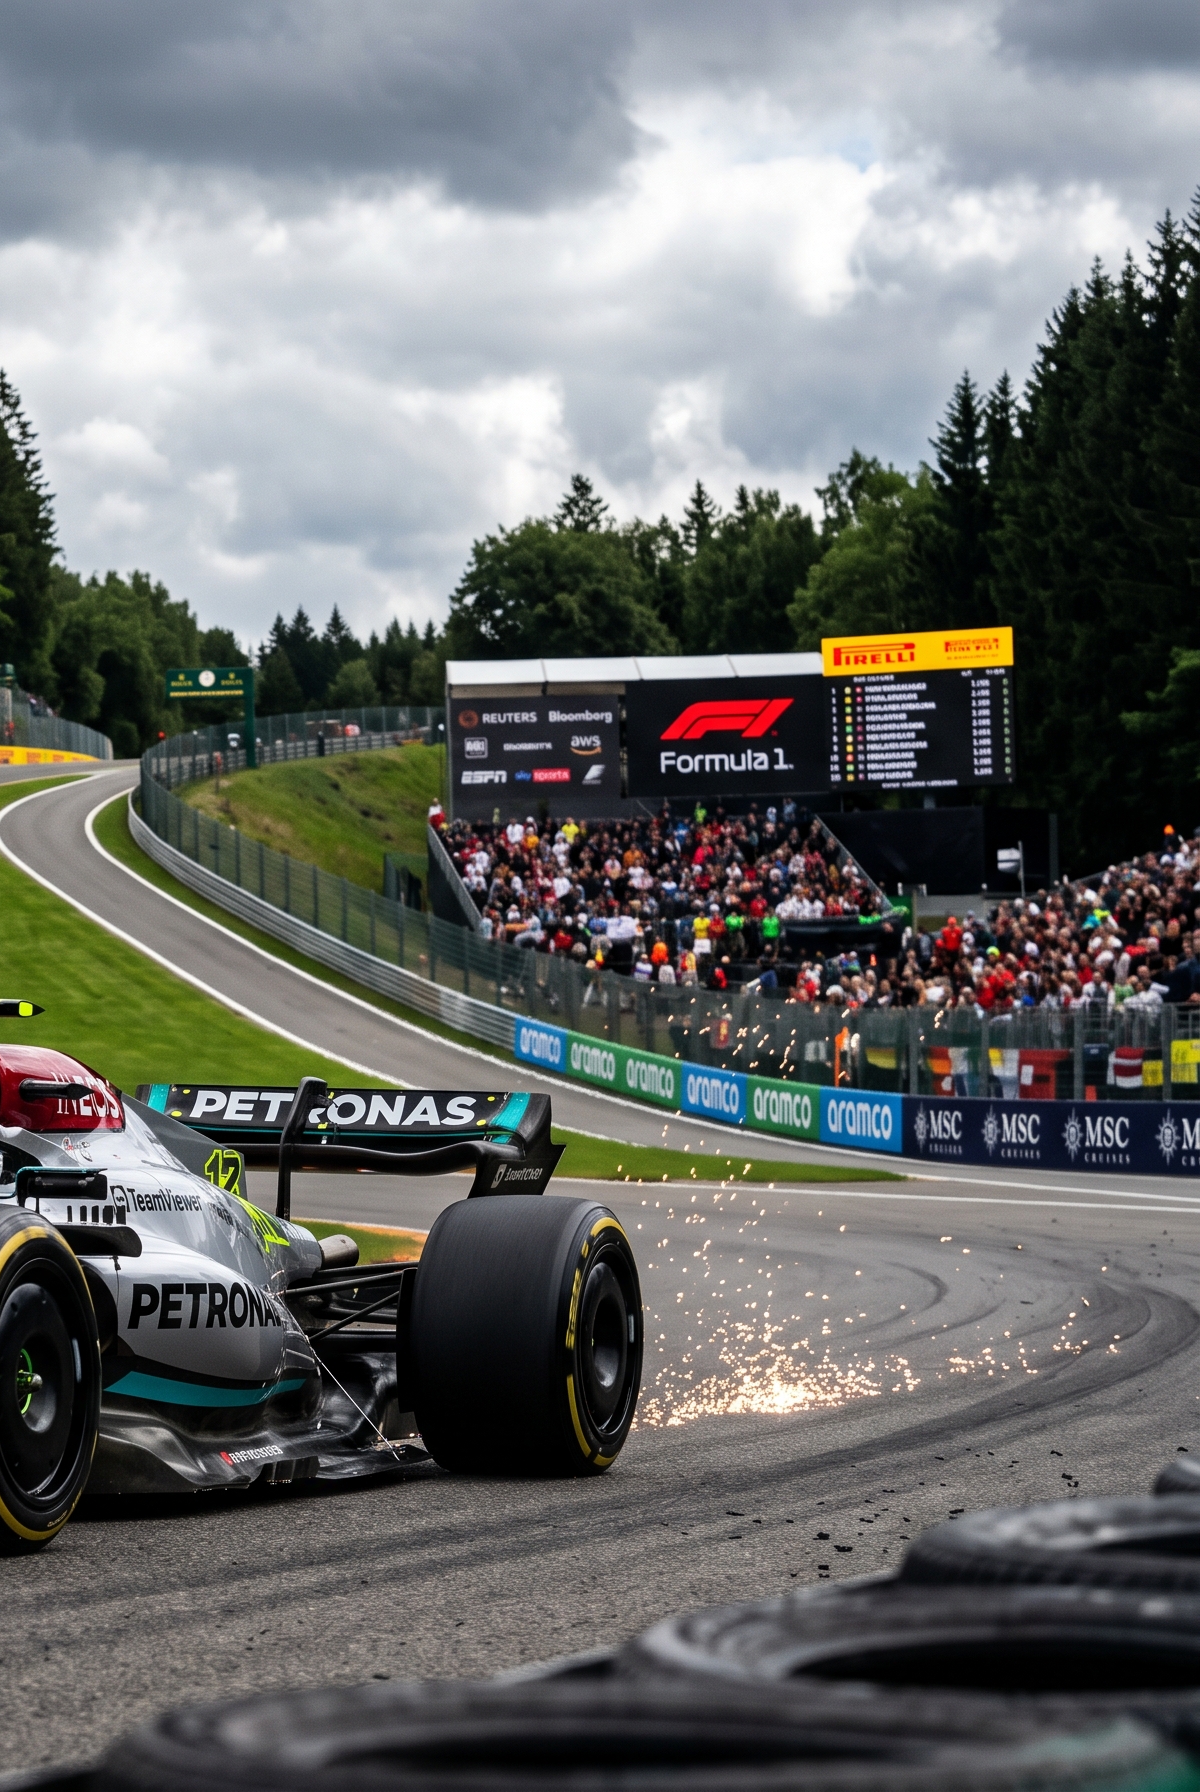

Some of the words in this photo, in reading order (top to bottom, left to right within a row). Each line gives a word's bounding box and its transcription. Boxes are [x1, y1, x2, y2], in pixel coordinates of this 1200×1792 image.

[833, 642, 915, 666] PIRELLI
[482, 711, 538, 724] REUTERS
[570, 735, 601, 747] aws
[660, 749, 769, 774] Formula
[461, 770, 508, 785] ESPN
[520, 1025, 562, 1065] aramco
[570, 1039, 616, 1082] aramco
[626, 1058, 674, 1100] aramco
[687, 1074, 740, 1115] aramco
[753, 1087, 812, 1129] aramco
[827, 1099, 893, 1141] aramco
[929, 1110, 963, 1140] MSC
[1001, 1113, 1041, 1144] MSC
[1084, 1116, 1130, 1149] MSC
[126, 1187, 203, 1213] TeamViewer
